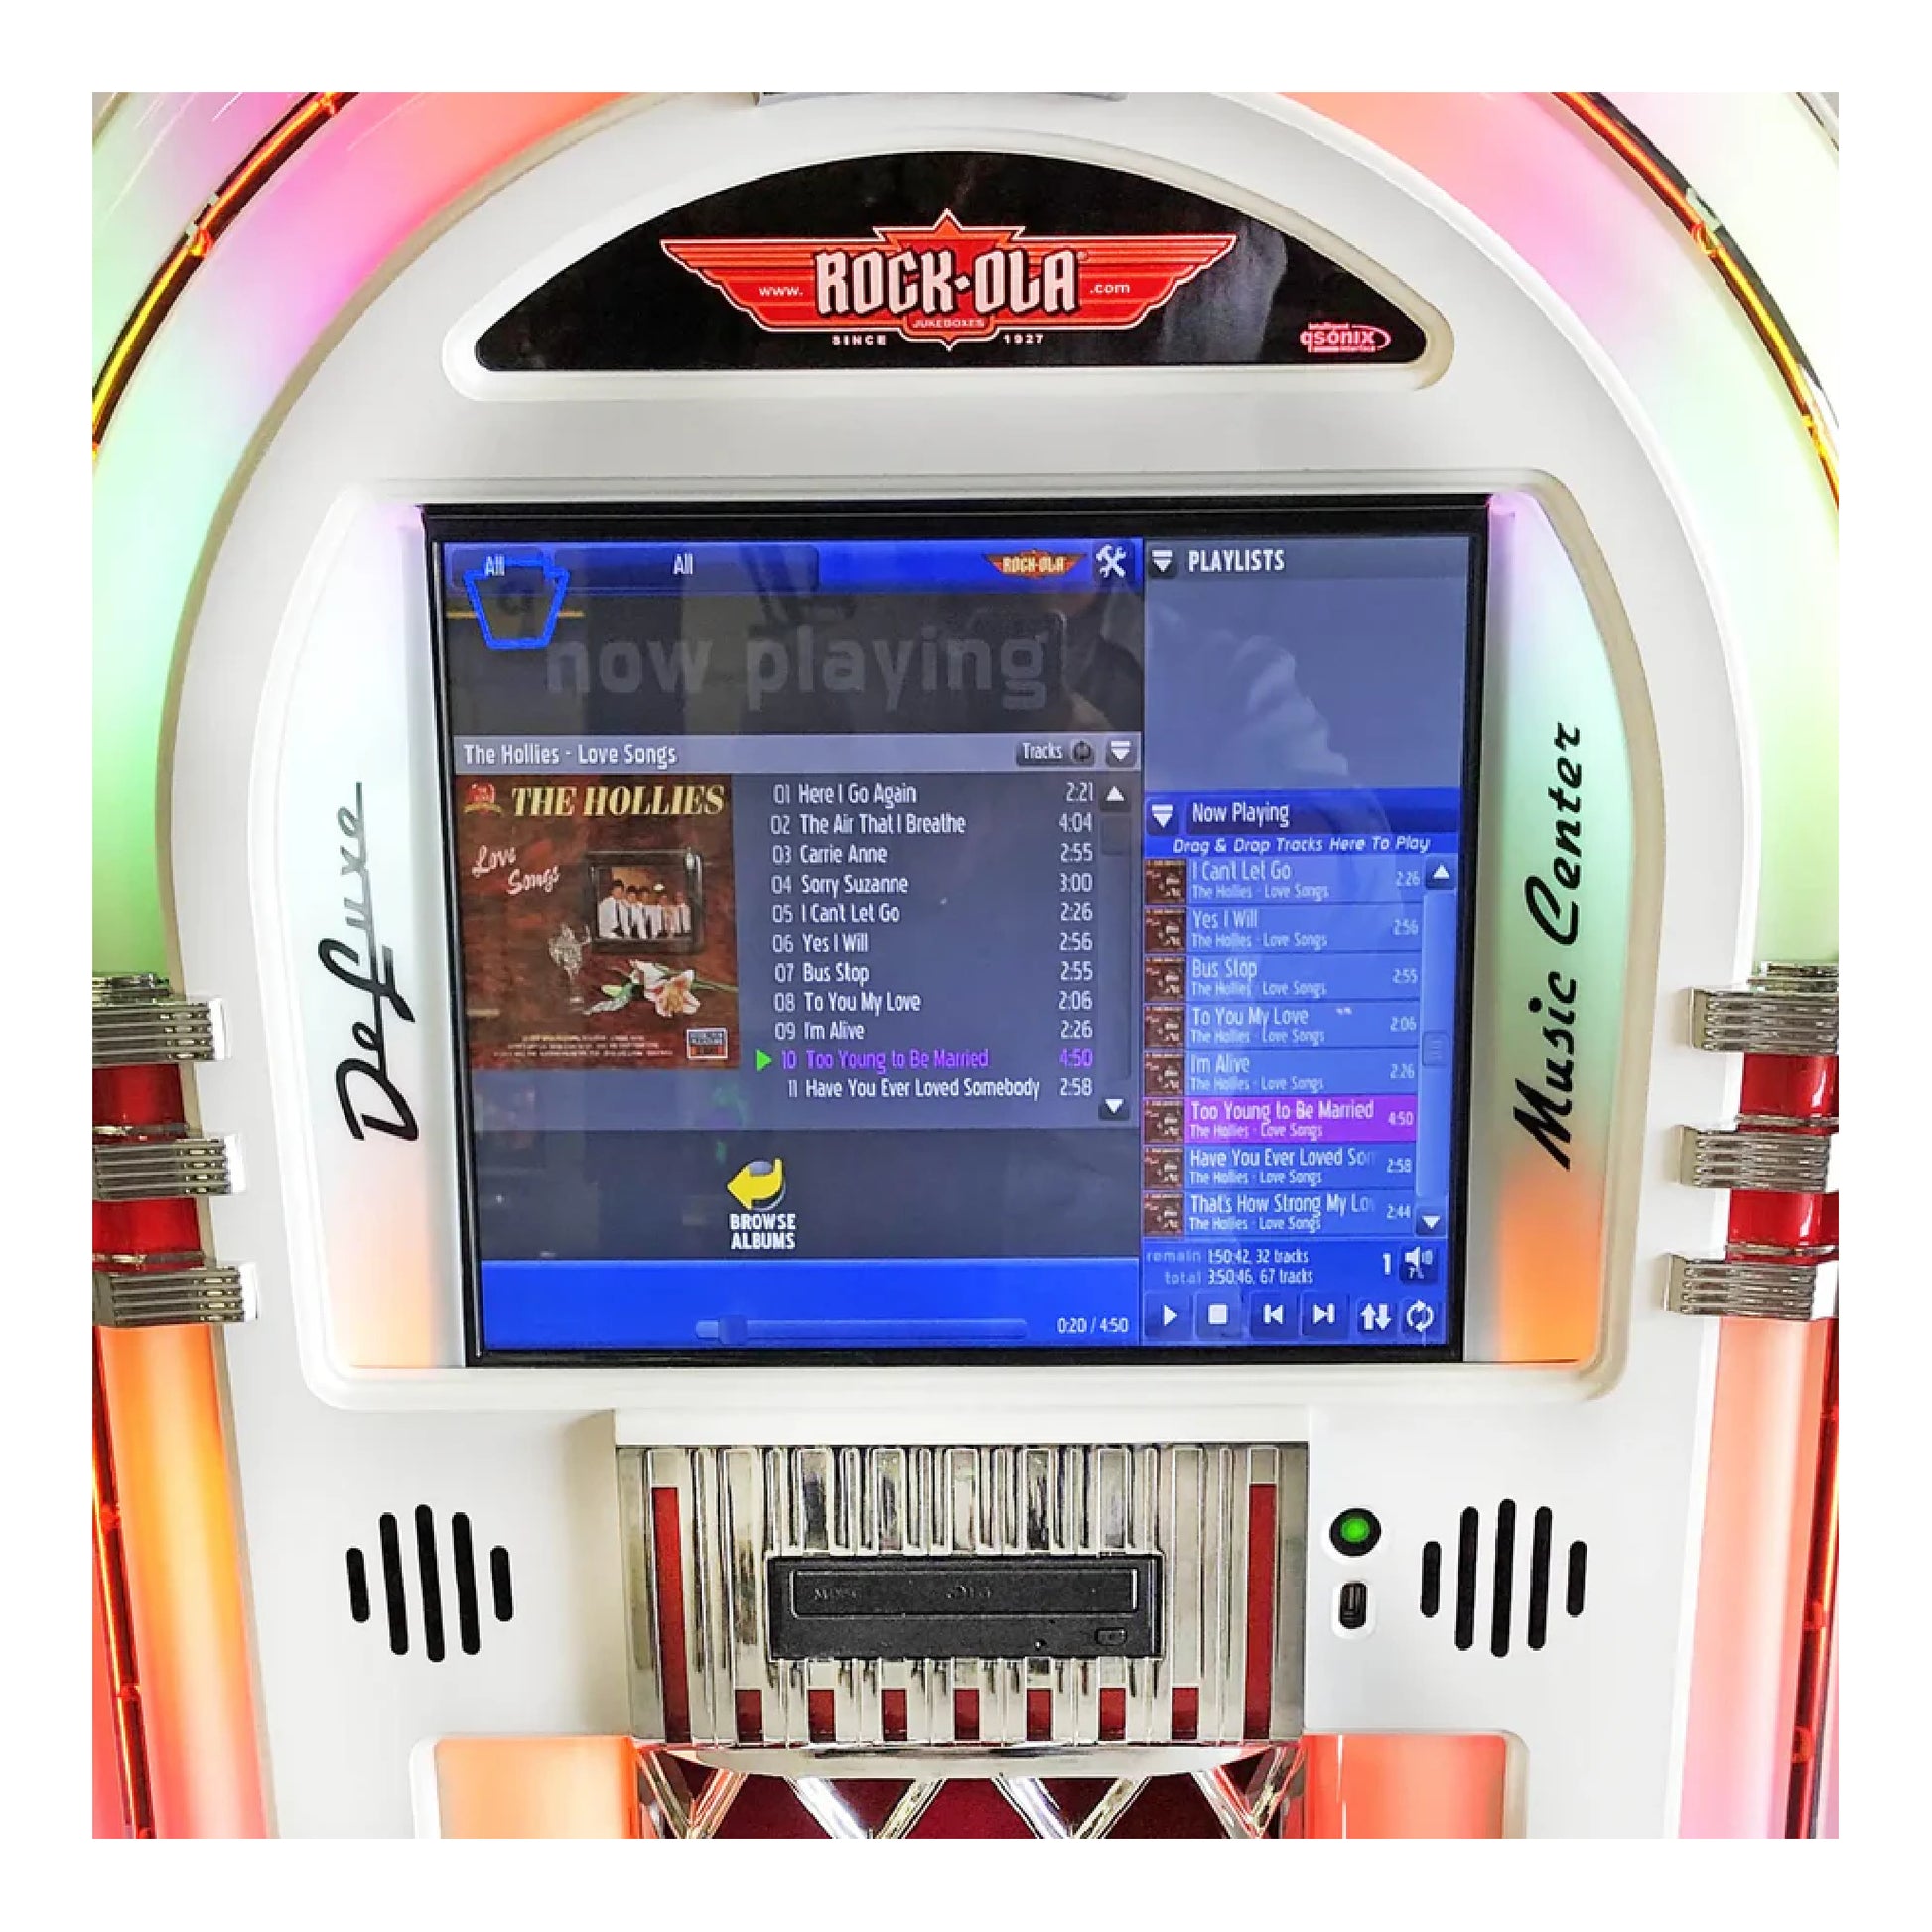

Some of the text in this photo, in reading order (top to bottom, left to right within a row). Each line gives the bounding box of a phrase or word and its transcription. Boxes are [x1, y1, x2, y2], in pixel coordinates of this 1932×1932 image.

[758, 286, 804, 296] www.
[1090, 282, 1130, 294] .com
[832, 334, 1044, 345] SINCE 1927
[485, 555, 505, 576] All
[673, 553, 693, 575] All
[1188, 550, 1284, 572] PLAYLISTS
[547, 627, 1047, 711] now playing
[463, 744, 495, 764] The
[501, 743, 559, 764] Hollies
[578, 744, 618, 764] Love
[623, 744, 678, 769] Songs
[1022, 743, 1063, 759] Tracks
[512, 786, 577, 816] THE
[583, 785, 725, 816] HOLLIES
[798, 784, 835, 803] Here
[848, 784, 870, 803] Go
[873, 783, 917, 808] Again
[1066, 782, 1094, 802] 2:21
[771, 816, 791, 834] 02
[800, 815, 830, 834] The
[833, 815, 854, 834] Air
[859, 814, 895, 834] That
[906, 813, 966, 833] Breathe
[1058, 813, 1092, 832] 4:04
[1192, 801, 1290, 828] Now Playing
[772, 843, 1092, 863] 03 Carrie Anne 2:55
[1173, 836, 1431, 855] Drag & Drop Tracks Here To Play
[472, 845, 516, 878] Love
[1243, 861, 1266, 881] Let
[1270, 860, 1291, 880] Go
[506, 865, 560, 894] Songs
[771, 873, 1092, 899] 04 Sorry Suzanne 3:00
[772, 904, 793, 923] 05
[851, 903, 875, 922] Let
[878, 903, 900, 922] Go
[1060, 902, 1092, 921] 2:26
[1192, 911, 1218, 929] Yes
[1232, 910, 1258, 928] Will
[772, 934, 793, 952] 06
[802, 934, 830, 952] Yes
[842, 933, 868, 952] Will
[1059, 932, 1092, 951] 2:56
[1513, 722, 1583, 1171] Music Center
[774, 961, 1092, 987] 07 Bus Stop 2:55
[1192, 959, 1218, 978] Bus
[1225, 959, 1257, 981] Stop
[773, 991, 1092, 1017] 08 To You My Love 2:06
[1192, 1008, 1210, 1025] To
[1215, 1008, 1244, 1025] You
[1249, 1007, 1269, 1027] My
[1274, 1007, 1309, 1024] Love
[774, 1022, 795, 1040] 09
[829, 1020, 865, 1039] Alive
[1060, 1020, 1092, 1039] 2:26
[781, 1049, 1092, 1074] 10 Too Young to Be Married 4:50
[1215, 1055, 1250, 1073] Alive
[805, 1079, 843, 1098] Have
[848, 1078, 876, 1098] You
[881, 1078, 911, 1098] Ever
[915, 1078, 959, 1097] Loved
[963, 1077, 1041, 1100] Somebody
[1059, 1078, 1092, 1097] 2:58
[1190, 1100, 1219, 1120] Too
[1223, 1100, 1271, 1125] Young
[1276, 1100, 1291, 1119] to
[1296, 1100, 1313, 1119] Be
[1318, 1099, 1374, 1119] Married
[1190, 1149, 1227, 1168] Have
[1231, 1148, 1260, 1167] You
[1264, 1148, 1295, 1167] Ever
[1300, 1147, 1343, 1167] Loved
[1388, 1157, 1412, 1172] 2:58
[1237, 1194, 1269, 1213] How
[1274, 1193, 1321, 1218] Strong
[1326, 1193, 1346, 1217] My
[1386, 1204, 1412, 1219] 2:44
[730, 1213, 796, 1230] BROWSE
[730, 1233, 795, 1250] ALBUMS
[1146, 1251, 1202, 1263] remain
[1256, 1249, 1270, 1263] 32
[1274, 1249, 1309, 1263] tracks
[1383, 1252, 1391, 1276] 1
[1164, 1271, 1202, 1284] total
[1261, 1269, 1275, 1284] 67
[1280, 1269, 1313, 1284] tracks
[1057, 1317, 1128, 1333] 0:20 4:50
